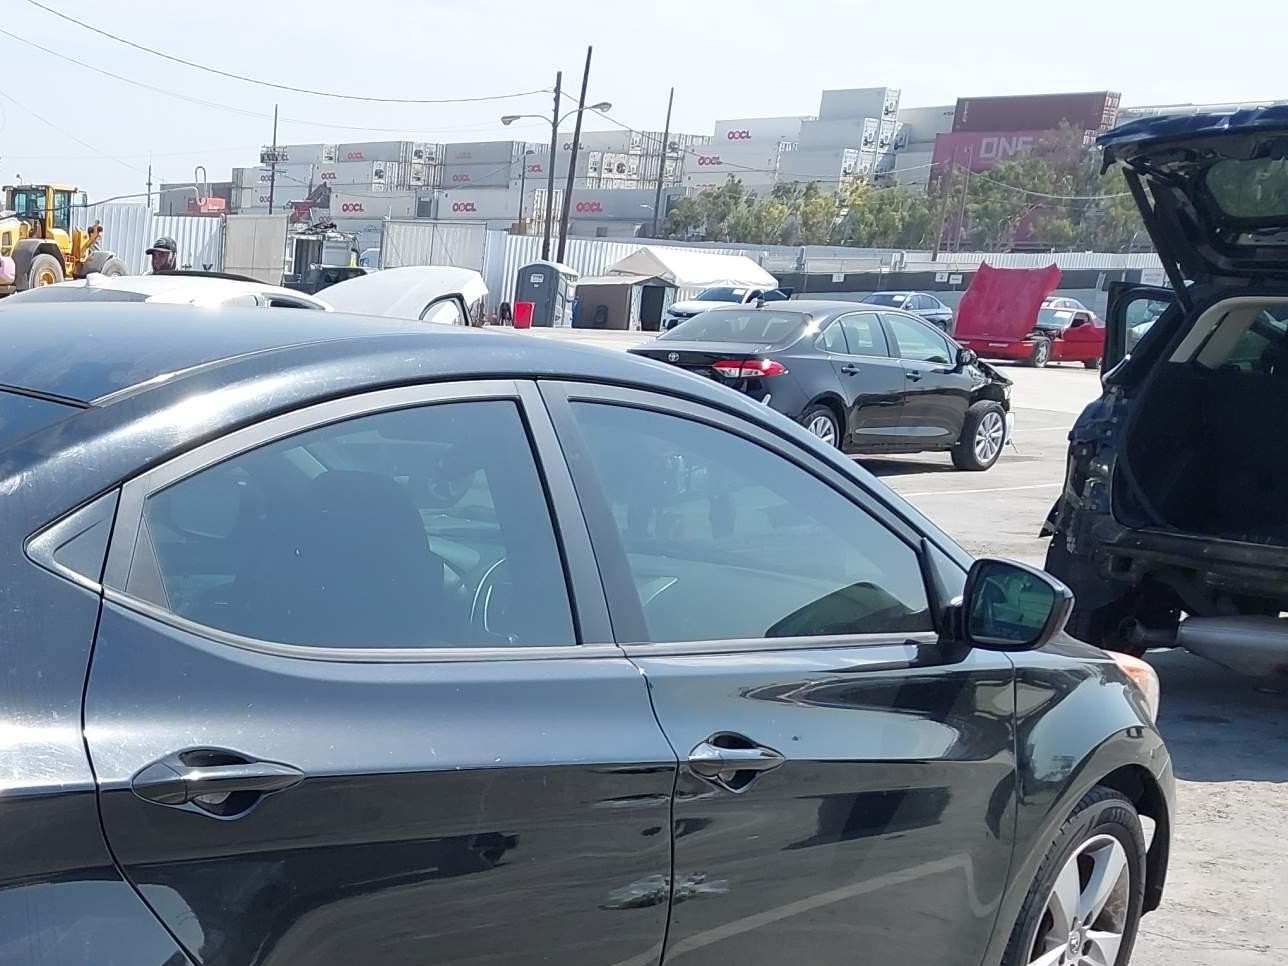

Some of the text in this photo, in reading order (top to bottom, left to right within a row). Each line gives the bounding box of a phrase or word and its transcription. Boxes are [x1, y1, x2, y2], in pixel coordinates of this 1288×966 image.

[727, 130, 751, 140] OOCL
[698, 156, 723, 165] OOCL
[342, 203, 365, 212] OOCL
[452, 203, 477, 212] OOCL
[576, 202, 603, 212] OOCL
